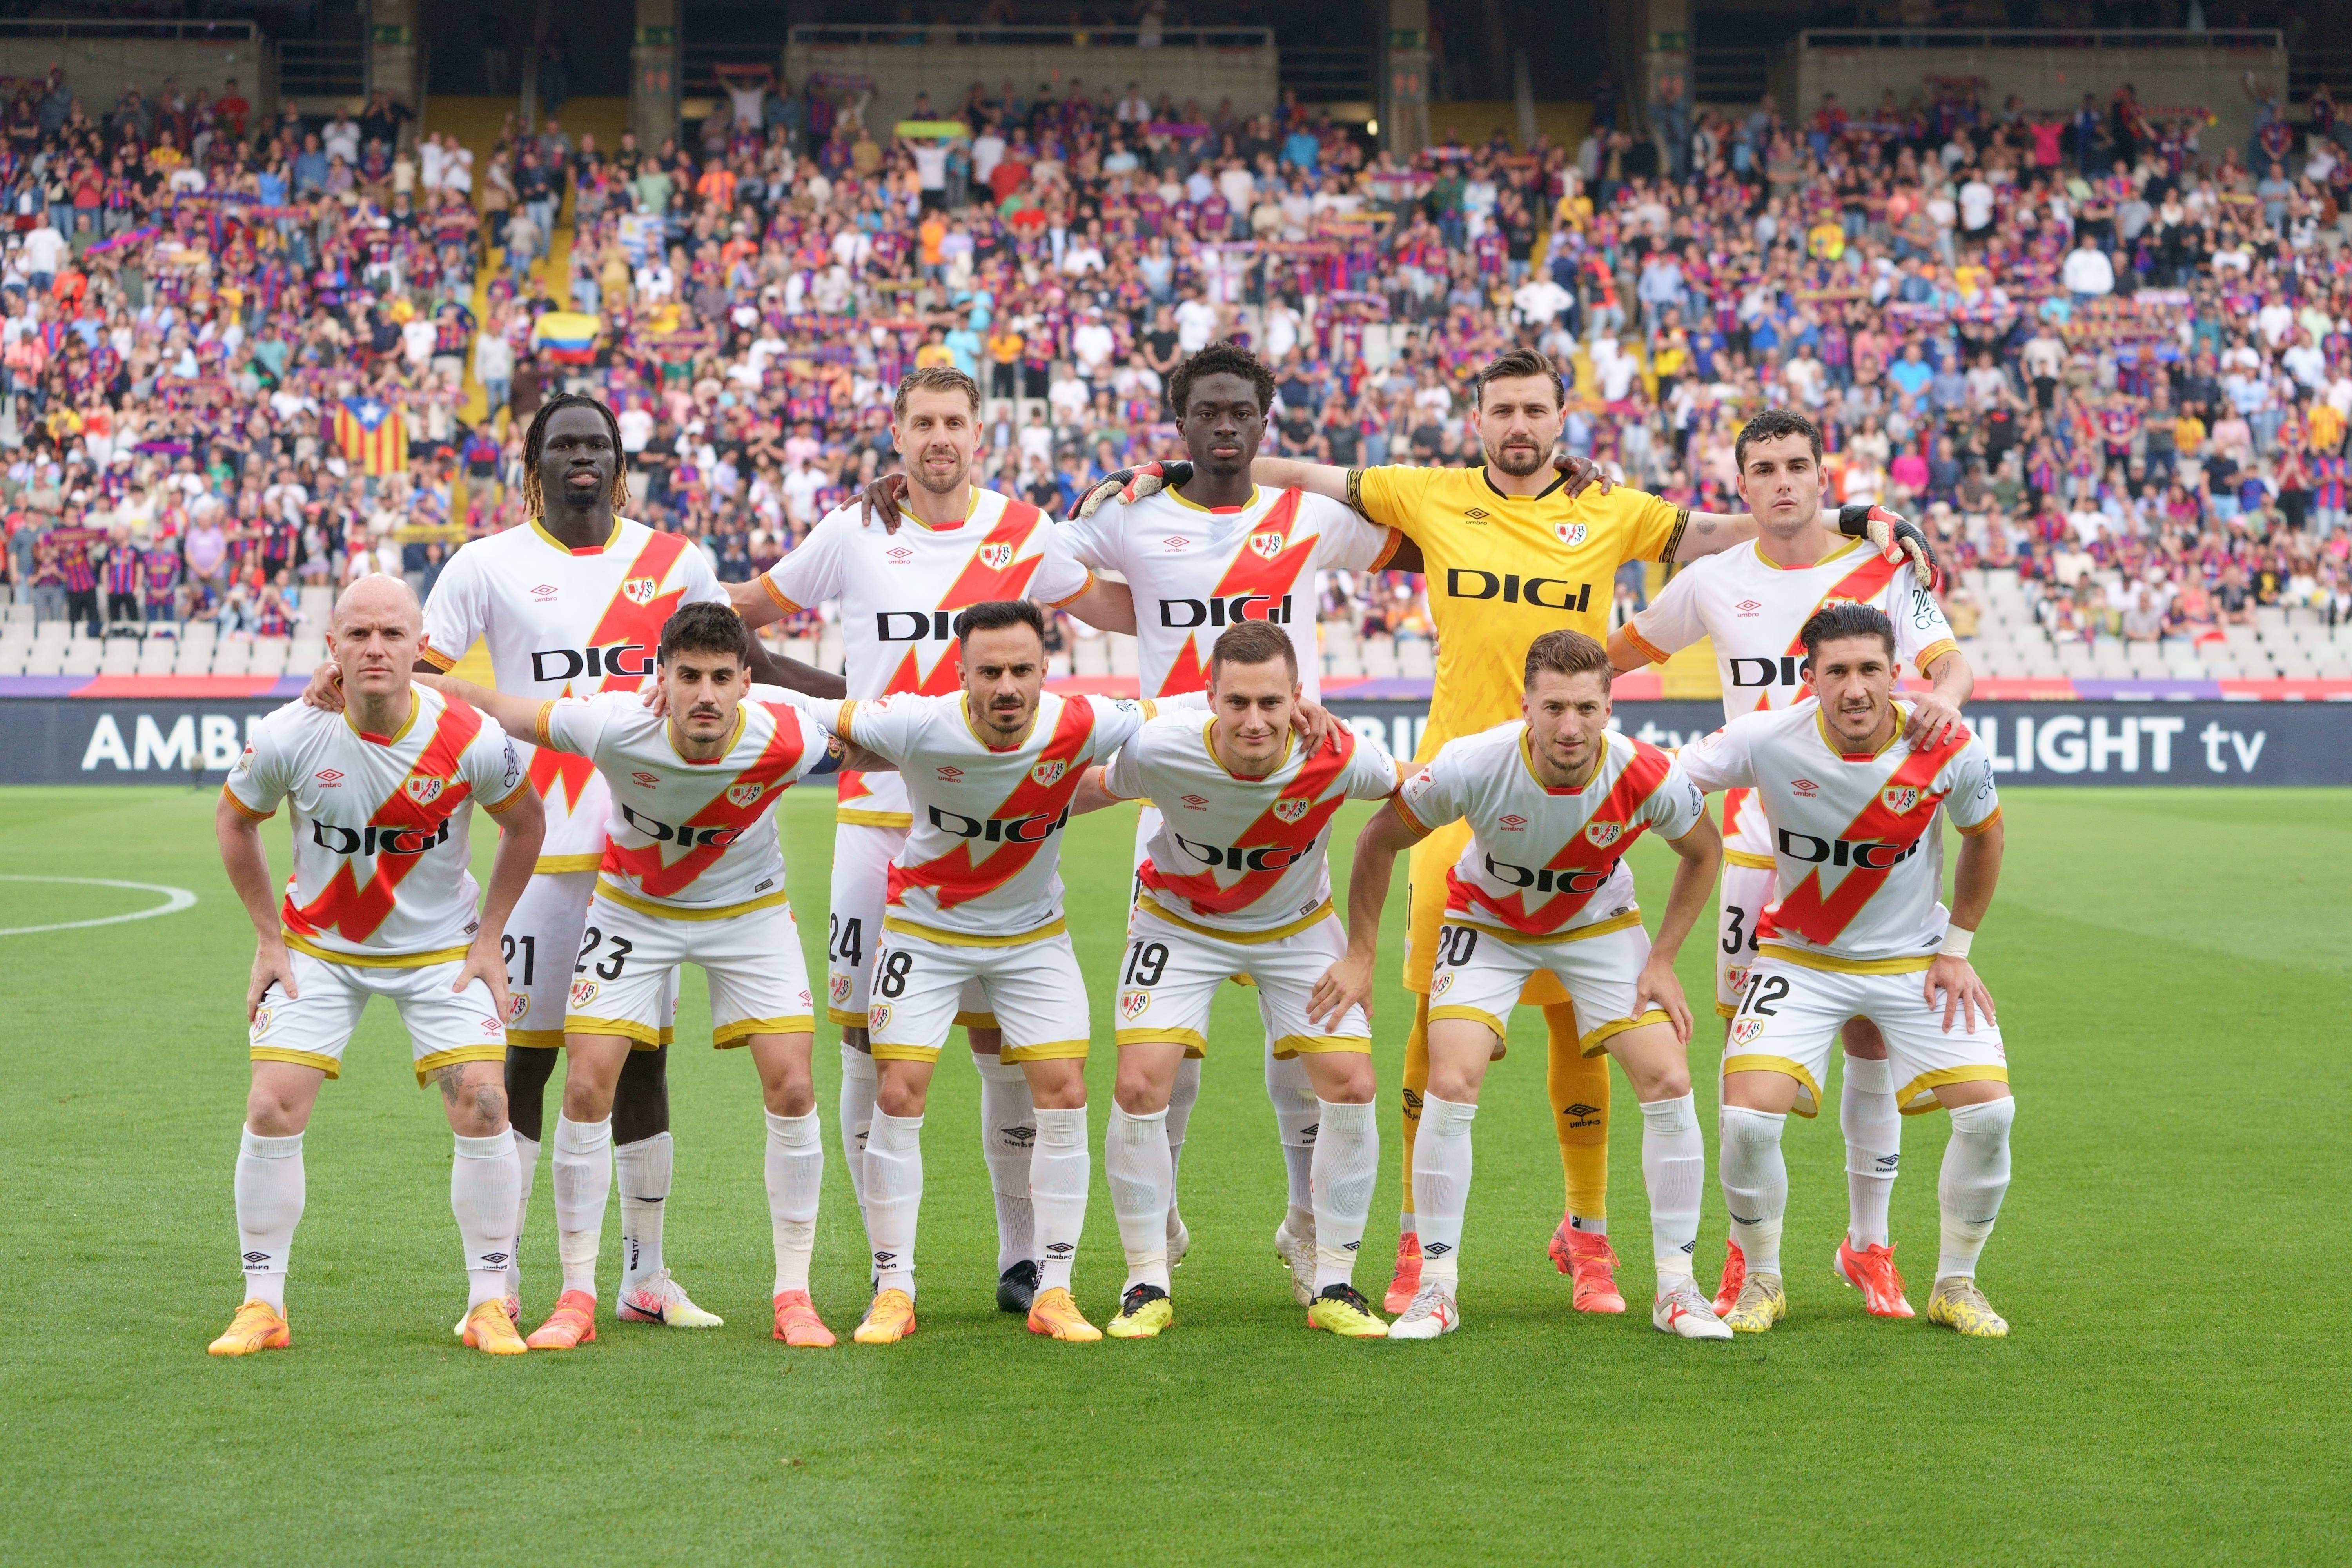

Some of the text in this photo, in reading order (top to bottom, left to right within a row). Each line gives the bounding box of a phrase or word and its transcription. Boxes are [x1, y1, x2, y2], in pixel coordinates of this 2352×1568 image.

[1447, 568, 1591, 612] DIGI
[877, 612, 965, 641] DI
[1730, 657, 1808, 686] DI
[2200, 722, 2266, 773] tv
[633, 780, 657, 789] umbro
[938, 775, 961, 784] umbro
[312, 819, 448, 856] DIGI
[622, 803, 762, 847] DIG
[929, 804, 1069, 842] DIGI
[1778, 827, 1920, 869] DIGI
[501, 934, 535, 986] 21
[575, 926, 632, 980] 23
[829, 913, 862, 967] 24
[1434, 926, 1477, 972] 20
[873, 948, 912, 998] 18
[1125, 941, 1169, 986] 19
[1740, 974, 1790, 1016] 12
[1570, 1118, 1601, 1129] umbro
